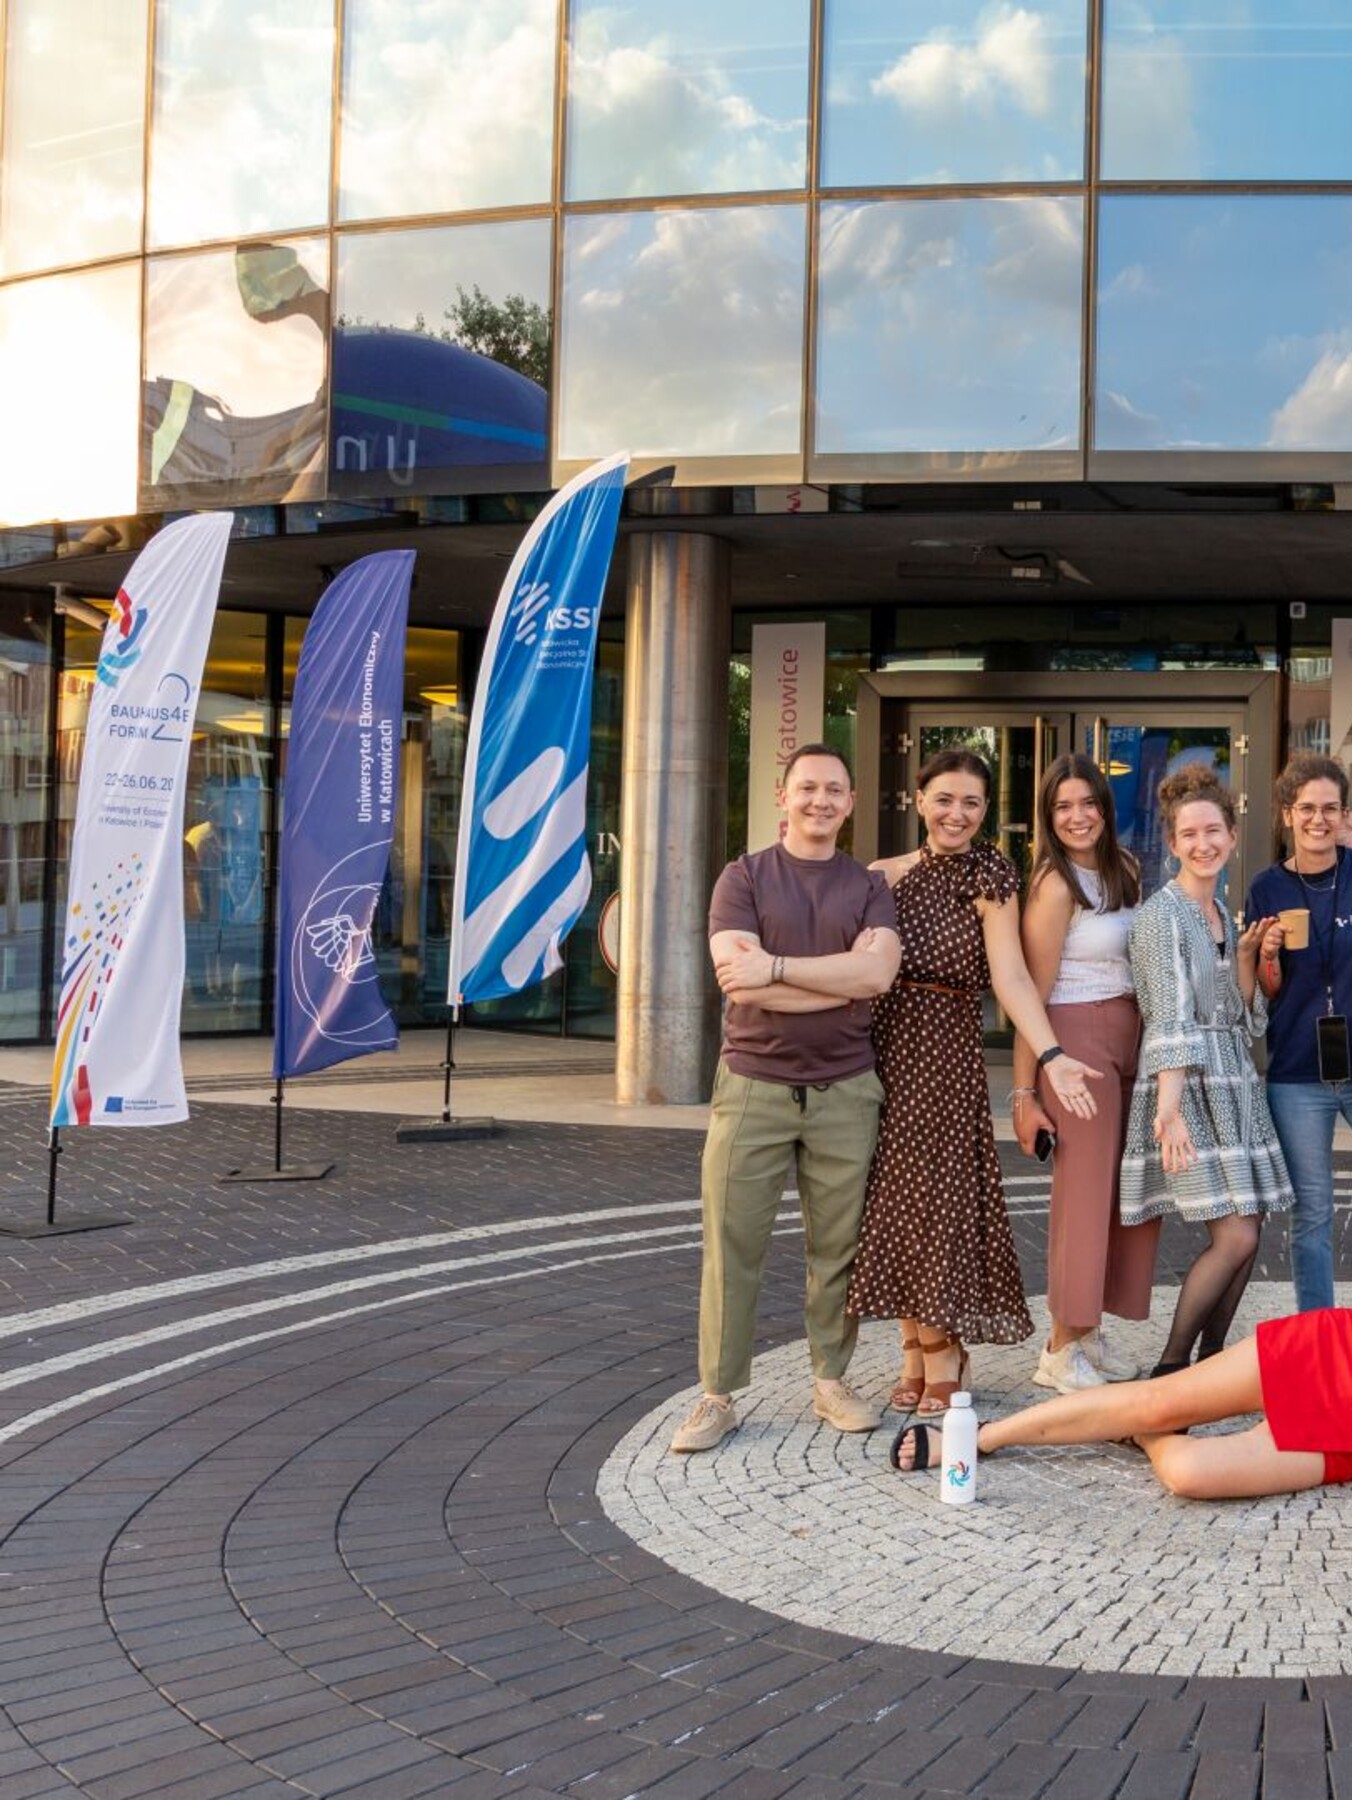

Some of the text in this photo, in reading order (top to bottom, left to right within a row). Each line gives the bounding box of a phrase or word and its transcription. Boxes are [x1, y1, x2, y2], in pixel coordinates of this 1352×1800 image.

[357, 630, 381, 822] Uniwersytet Ekonomiczny
[378, 719, 393, 823] w Katowicach
